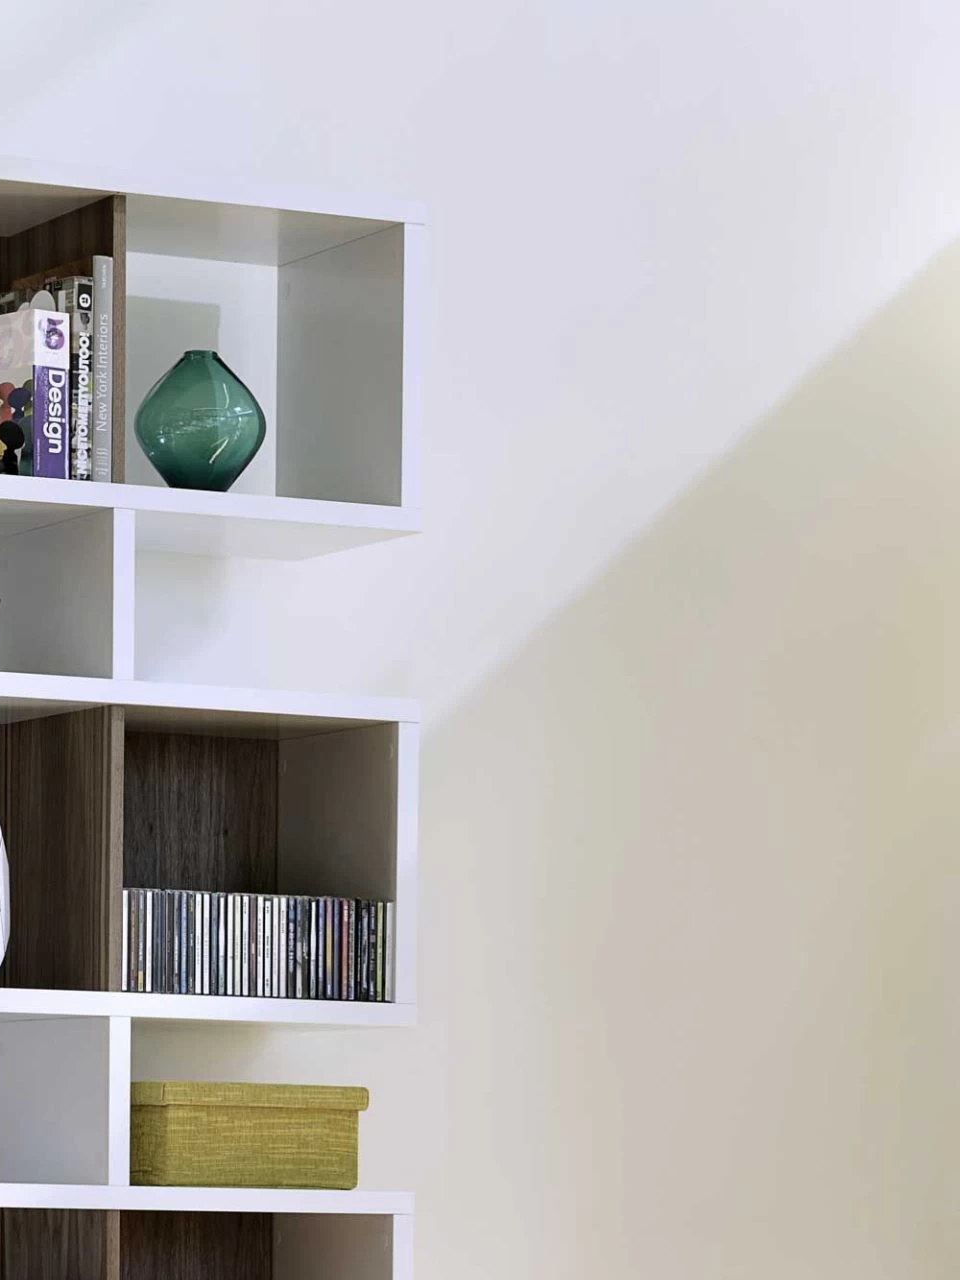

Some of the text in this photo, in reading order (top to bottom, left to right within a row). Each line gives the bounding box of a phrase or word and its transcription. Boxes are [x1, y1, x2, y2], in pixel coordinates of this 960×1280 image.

[43, 369, 66, 454] Design
[96, 314, 108, 431] New York Interiors
